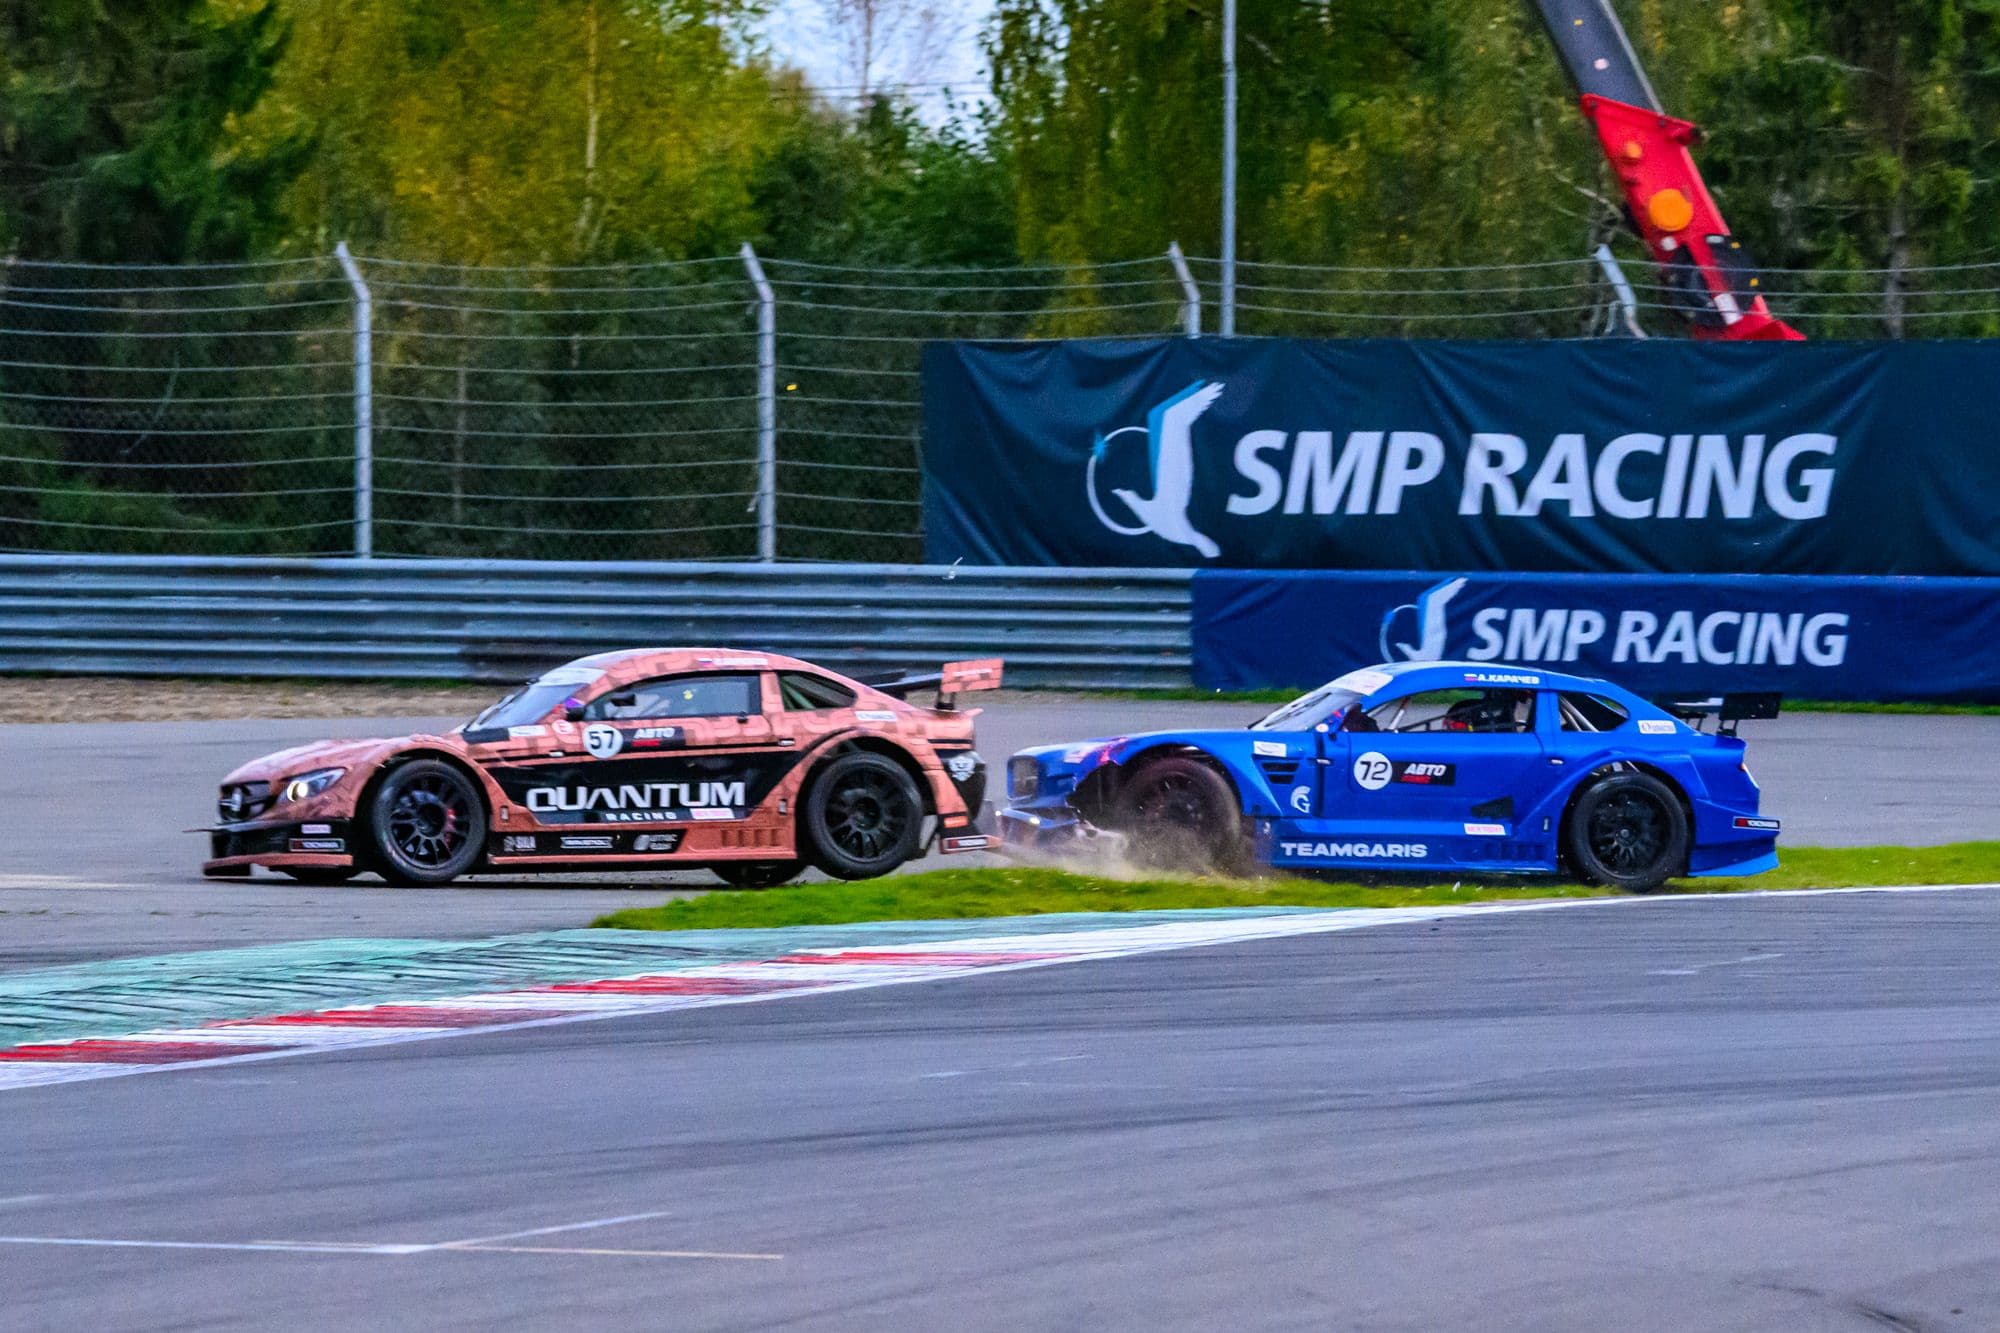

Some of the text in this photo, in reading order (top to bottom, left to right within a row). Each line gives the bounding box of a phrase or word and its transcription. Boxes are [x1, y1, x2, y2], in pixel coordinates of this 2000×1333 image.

[1226, 430, 1836, 519] SMP RACING
[1467, 608, 1849, 667] SMP RACING
[588, 730, 614, 750] 57
[1360, 761, 1388, 781] 72
[526, 782, 745, 812] QUANTUM
[605, 811, 677, 822] RACING
[1280, 843, 1428, 857] TEAMGARIS
